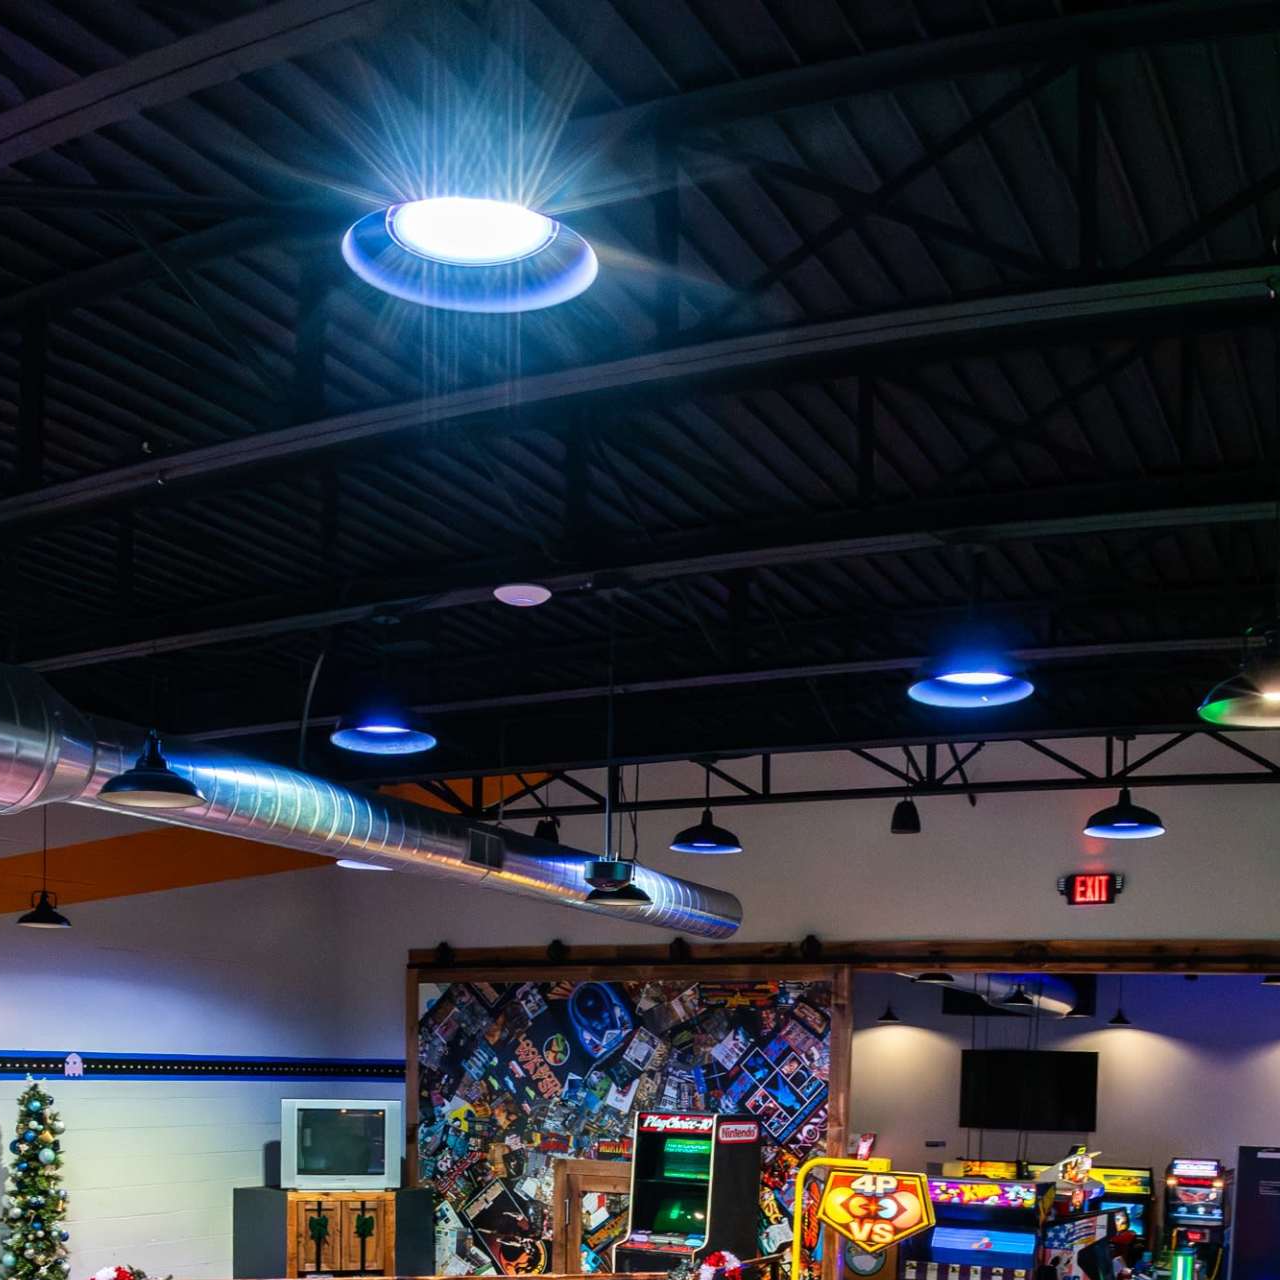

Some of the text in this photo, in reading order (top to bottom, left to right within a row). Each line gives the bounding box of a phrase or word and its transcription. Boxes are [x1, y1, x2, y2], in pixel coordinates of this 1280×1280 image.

[1074, 875, 1108, 902] EXIT
[643, 1116, 713, 1131] PlayChoice-10
[721, 1126, 757, 1139] Nintendo
[850, 1174, 898, 1196] 4P
[849, 1219, 896, 1245] VS
